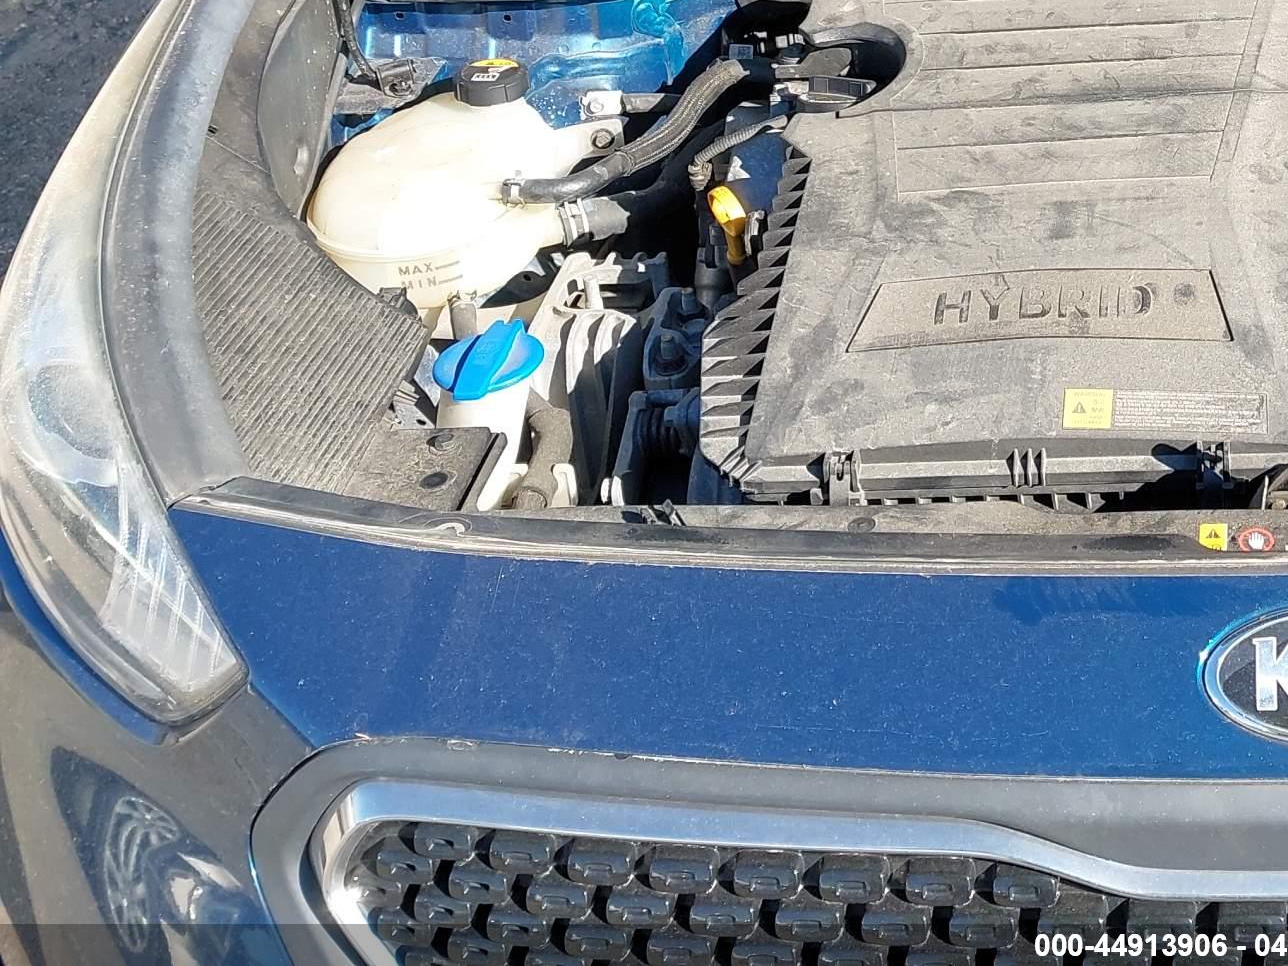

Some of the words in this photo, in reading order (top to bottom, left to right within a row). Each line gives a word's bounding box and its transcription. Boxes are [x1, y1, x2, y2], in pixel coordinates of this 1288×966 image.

[398, 262, 433, 276] MAX
[401, 276, 437, 290] MIN
[933, 283, 1152, 325] HYBRID
